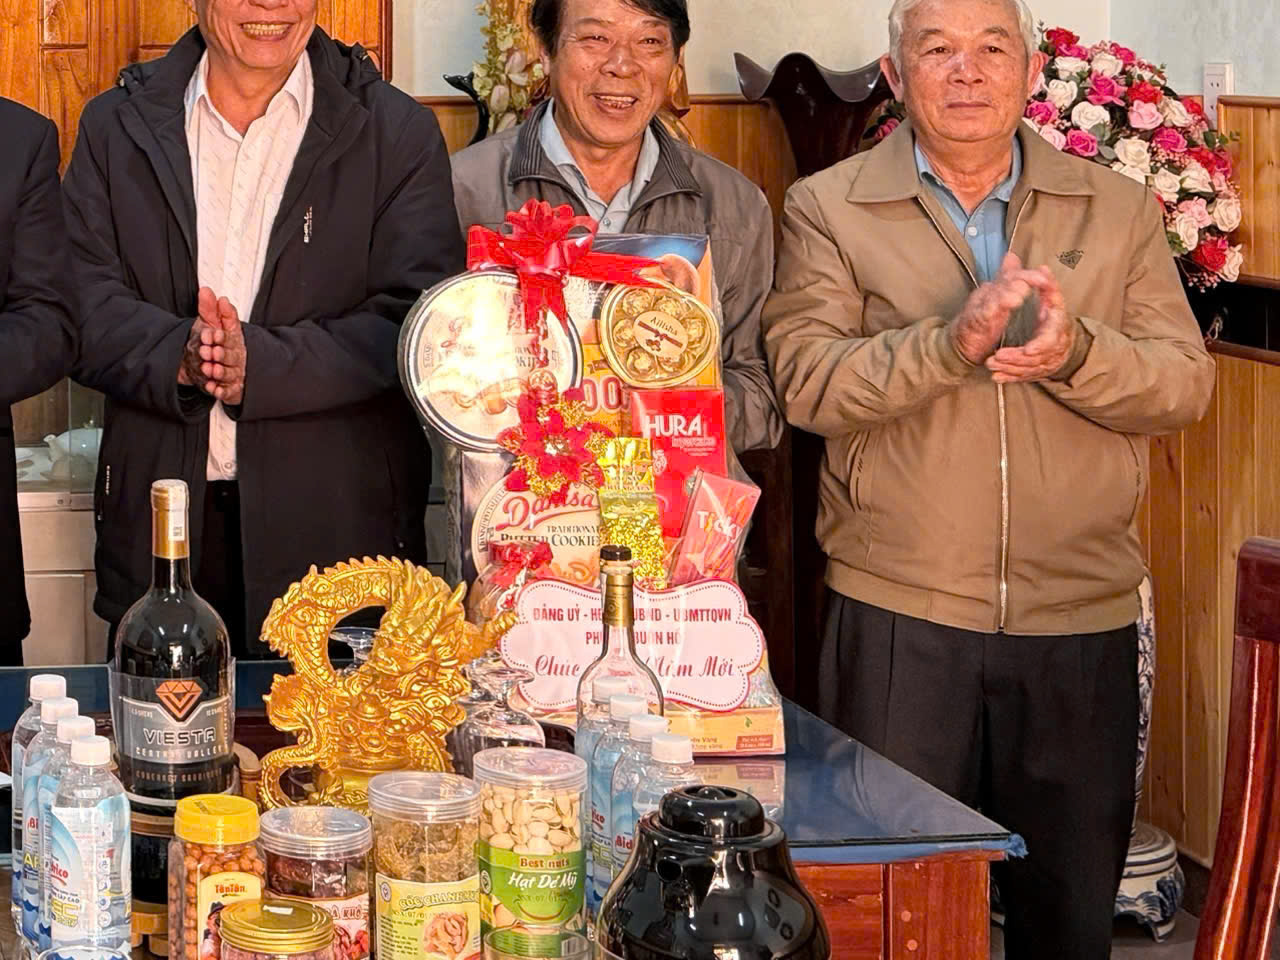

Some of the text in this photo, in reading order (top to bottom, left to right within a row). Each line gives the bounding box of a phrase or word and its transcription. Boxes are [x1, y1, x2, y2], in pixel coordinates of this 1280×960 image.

[643, 413, 702, 437] HURA
[533, 604, 564, 622] ĐẢNG
[535, 654, 580, 677] Chúc
[698, 655, 734, 677] Mới
[143, 727, 216, 746] VIESTA
[520, 858, 569, 869] Best nuts
[508, 872, 536, 890] Hạt
[560, 871, 578, 890] Mỹ
